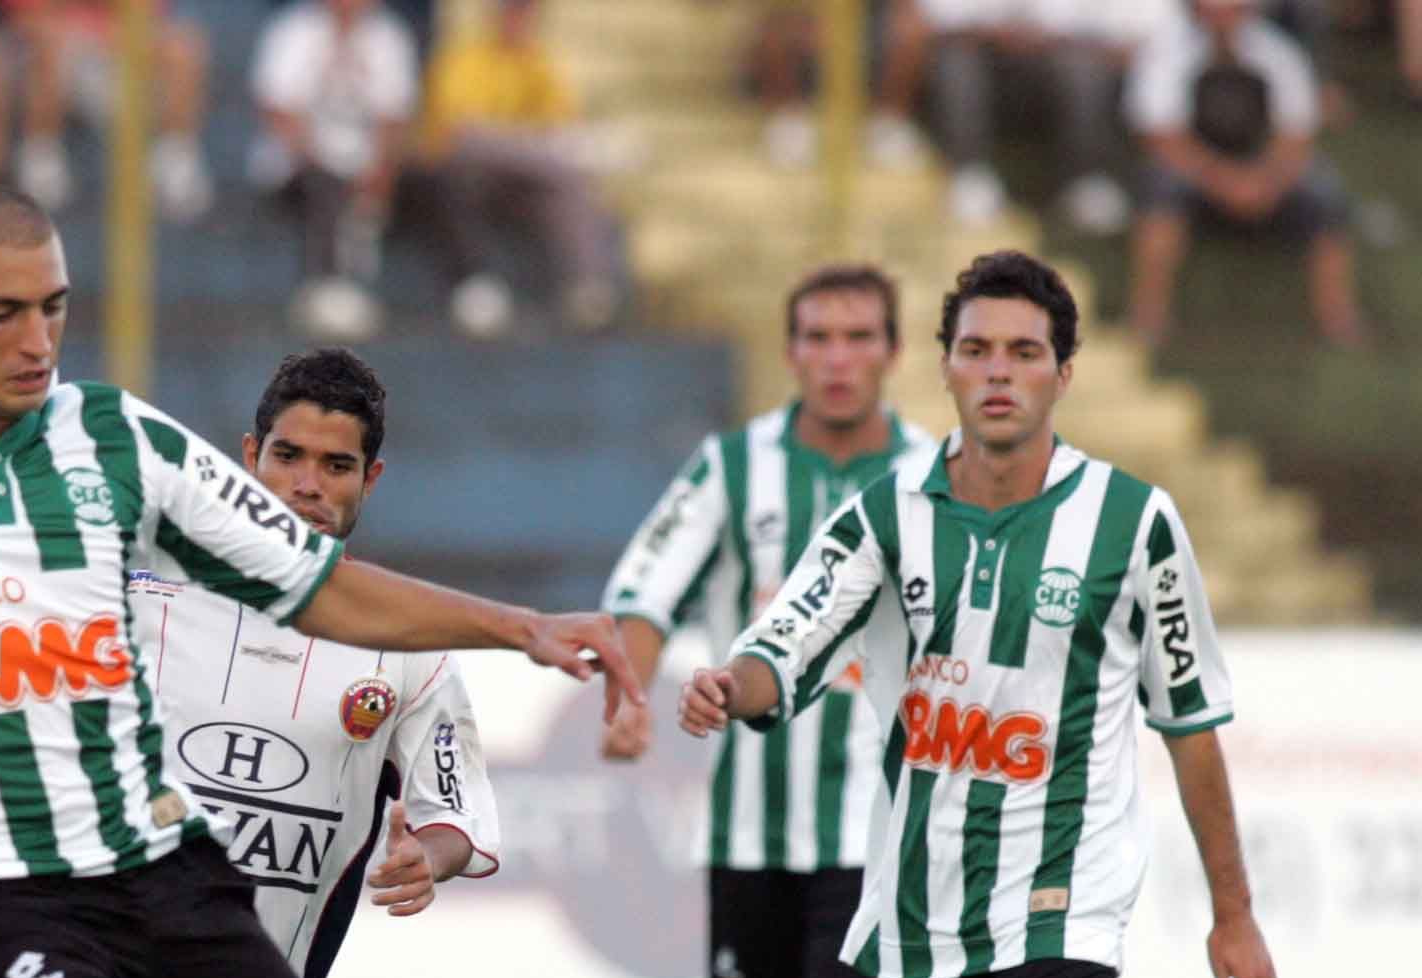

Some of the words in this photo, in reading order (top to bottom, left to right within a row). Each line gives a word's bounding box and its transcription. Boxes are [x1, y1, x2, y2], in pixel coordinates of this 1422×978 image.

[219, 475, 297, 547] IRA
[788, 547, 848, 621] IRA
[1035, 586, 1081, 609] CFC
[1155, 597, 1195, 681] IRA
[215, 730, 272, 784] H
[899, 688, 1051, 783] BMG
